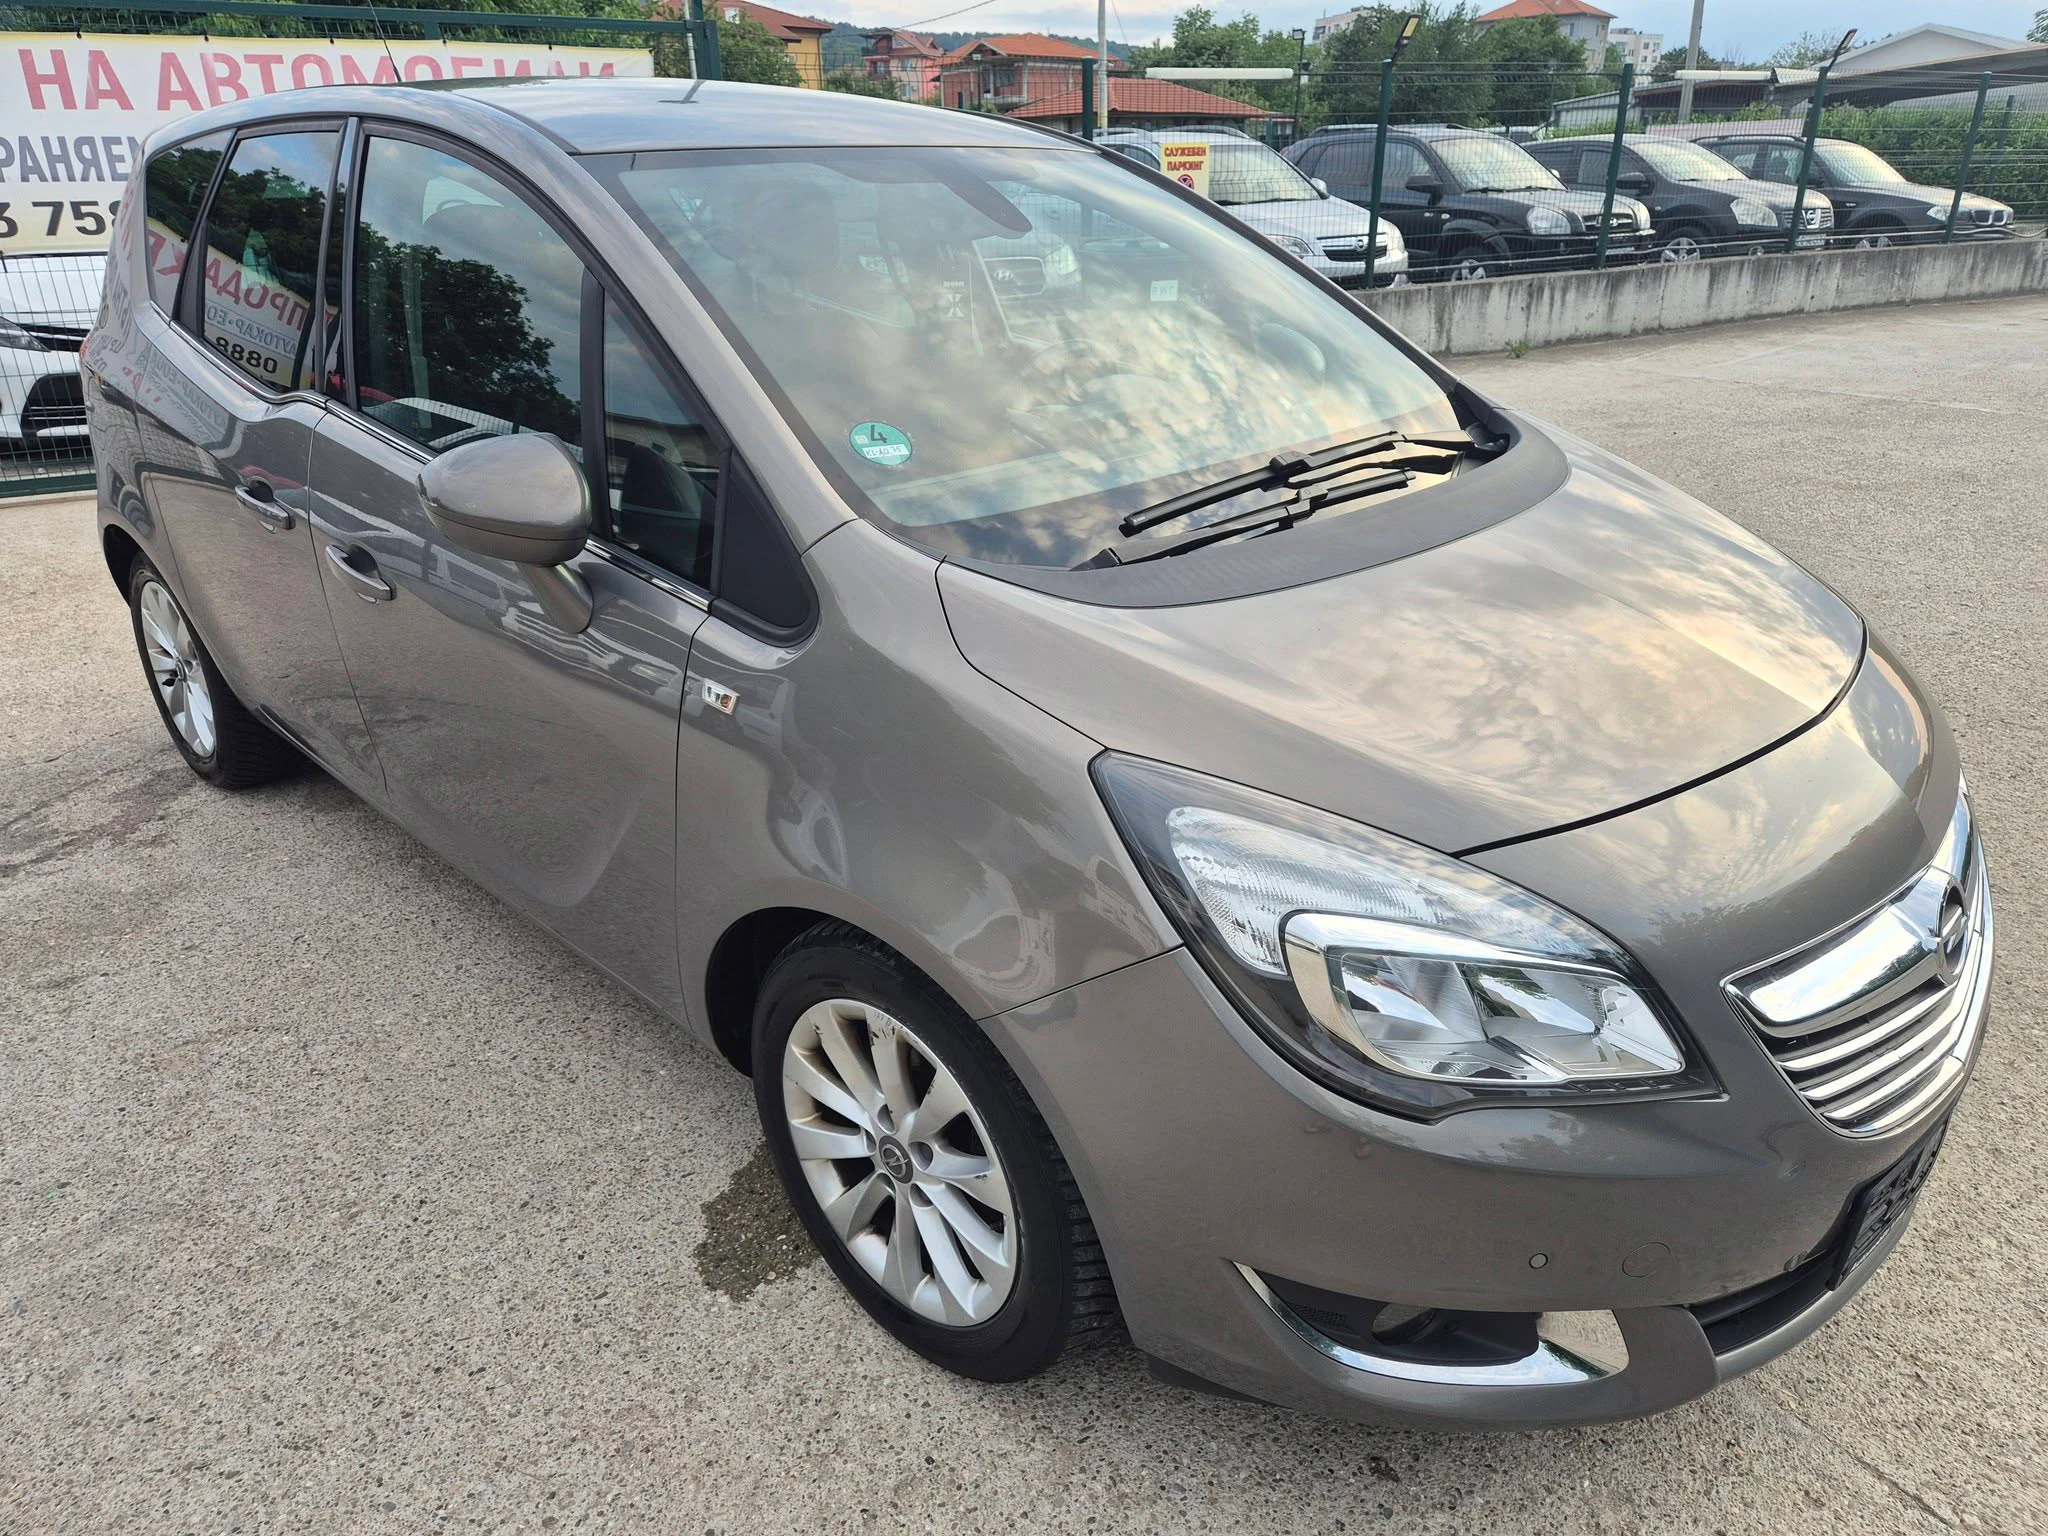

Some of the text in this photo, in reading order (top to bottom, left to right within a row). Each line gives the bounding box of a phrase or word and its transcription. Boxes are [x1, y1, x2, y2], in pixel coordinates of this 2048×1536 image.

[18, 49, 614, 110] НА АВТОМ
[1167, 161, 1204, 171] ПАРКИНГ
[870, 424, 887, 443] 4
